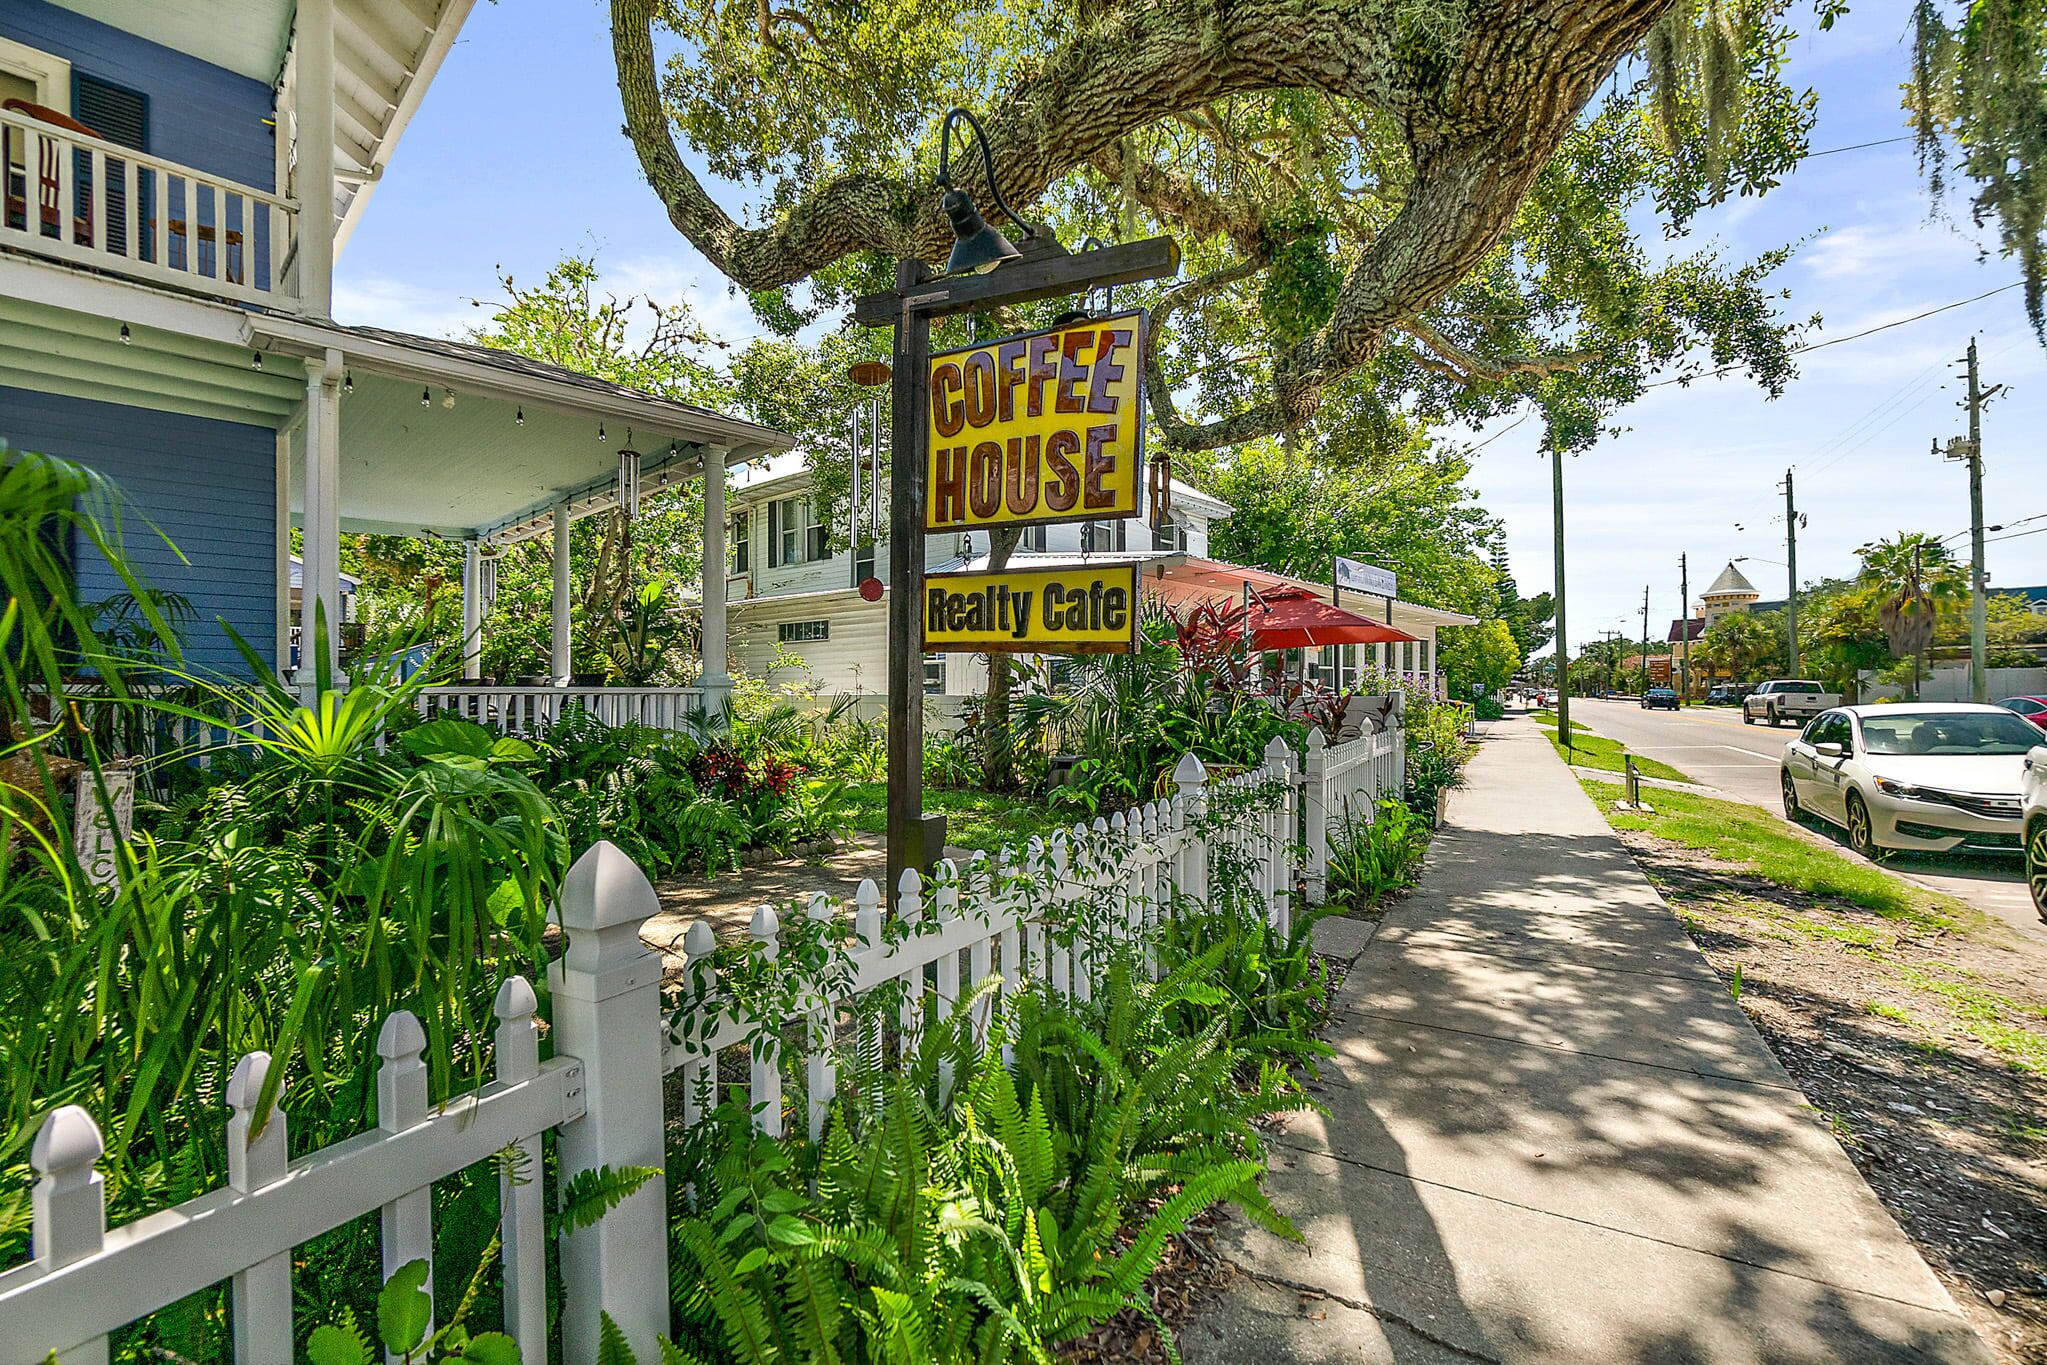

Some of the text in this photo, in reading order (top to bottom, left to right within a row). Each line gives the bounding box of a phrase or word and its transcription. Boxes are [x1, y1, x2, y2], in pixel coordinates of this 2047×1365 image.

[931, 330, 1133, 437] COFFEE
[935, 424, 1117, 523] HOUSE
[928, 581, 1127, 638] Realty Cafe
